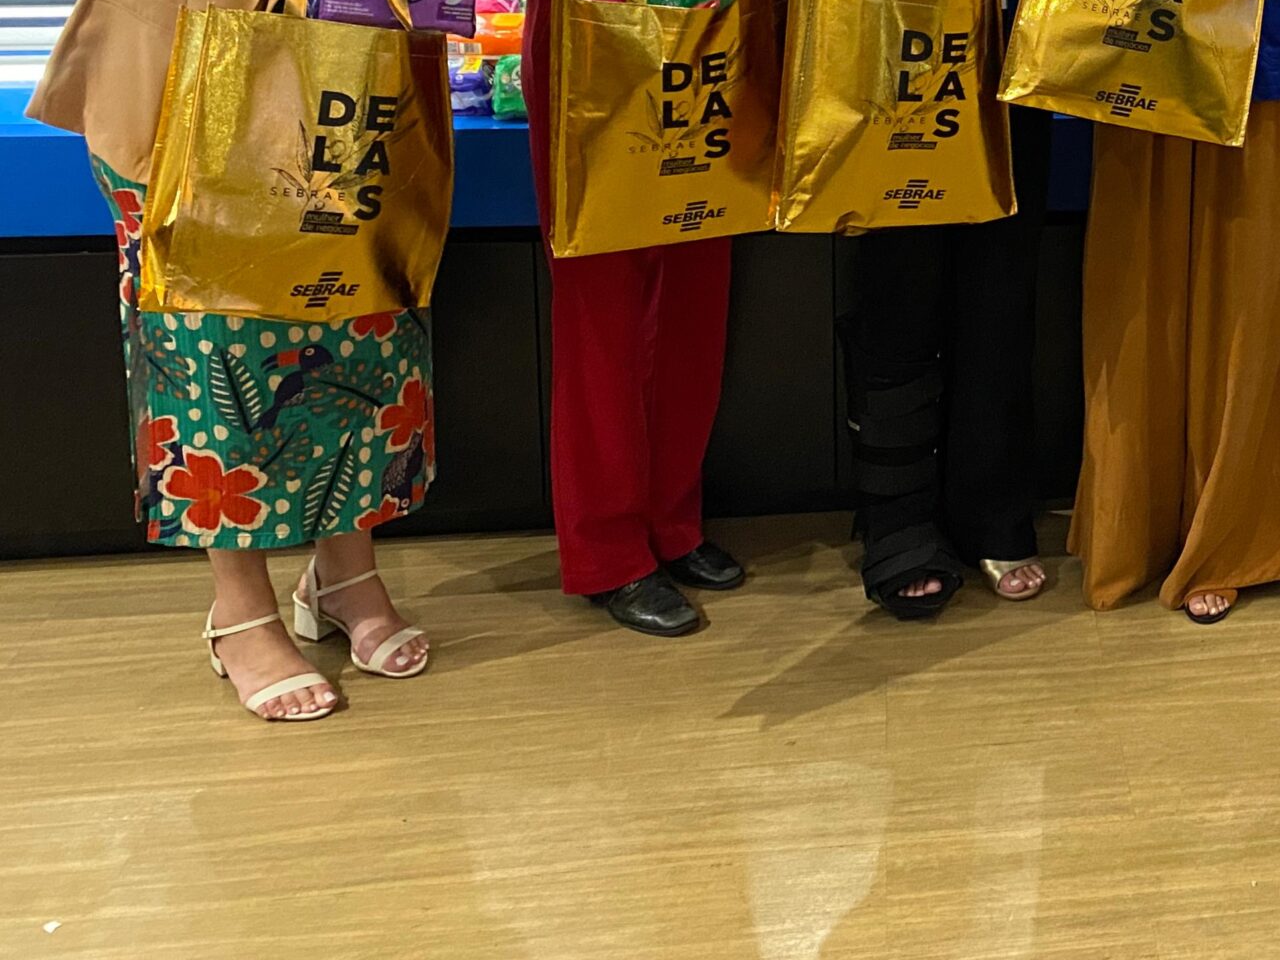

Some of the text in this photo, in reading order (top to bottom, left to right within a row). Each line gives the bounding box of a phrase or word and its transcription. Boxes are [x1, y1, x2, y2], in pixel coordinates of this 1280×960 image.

[1095, 90, 1158, 111] SEBRAE
[882, 187, 947, 202] SEBRAE
[662, 207, 727, 225] SEBRAE
[290, 284, 360, 297] SEBRAE
